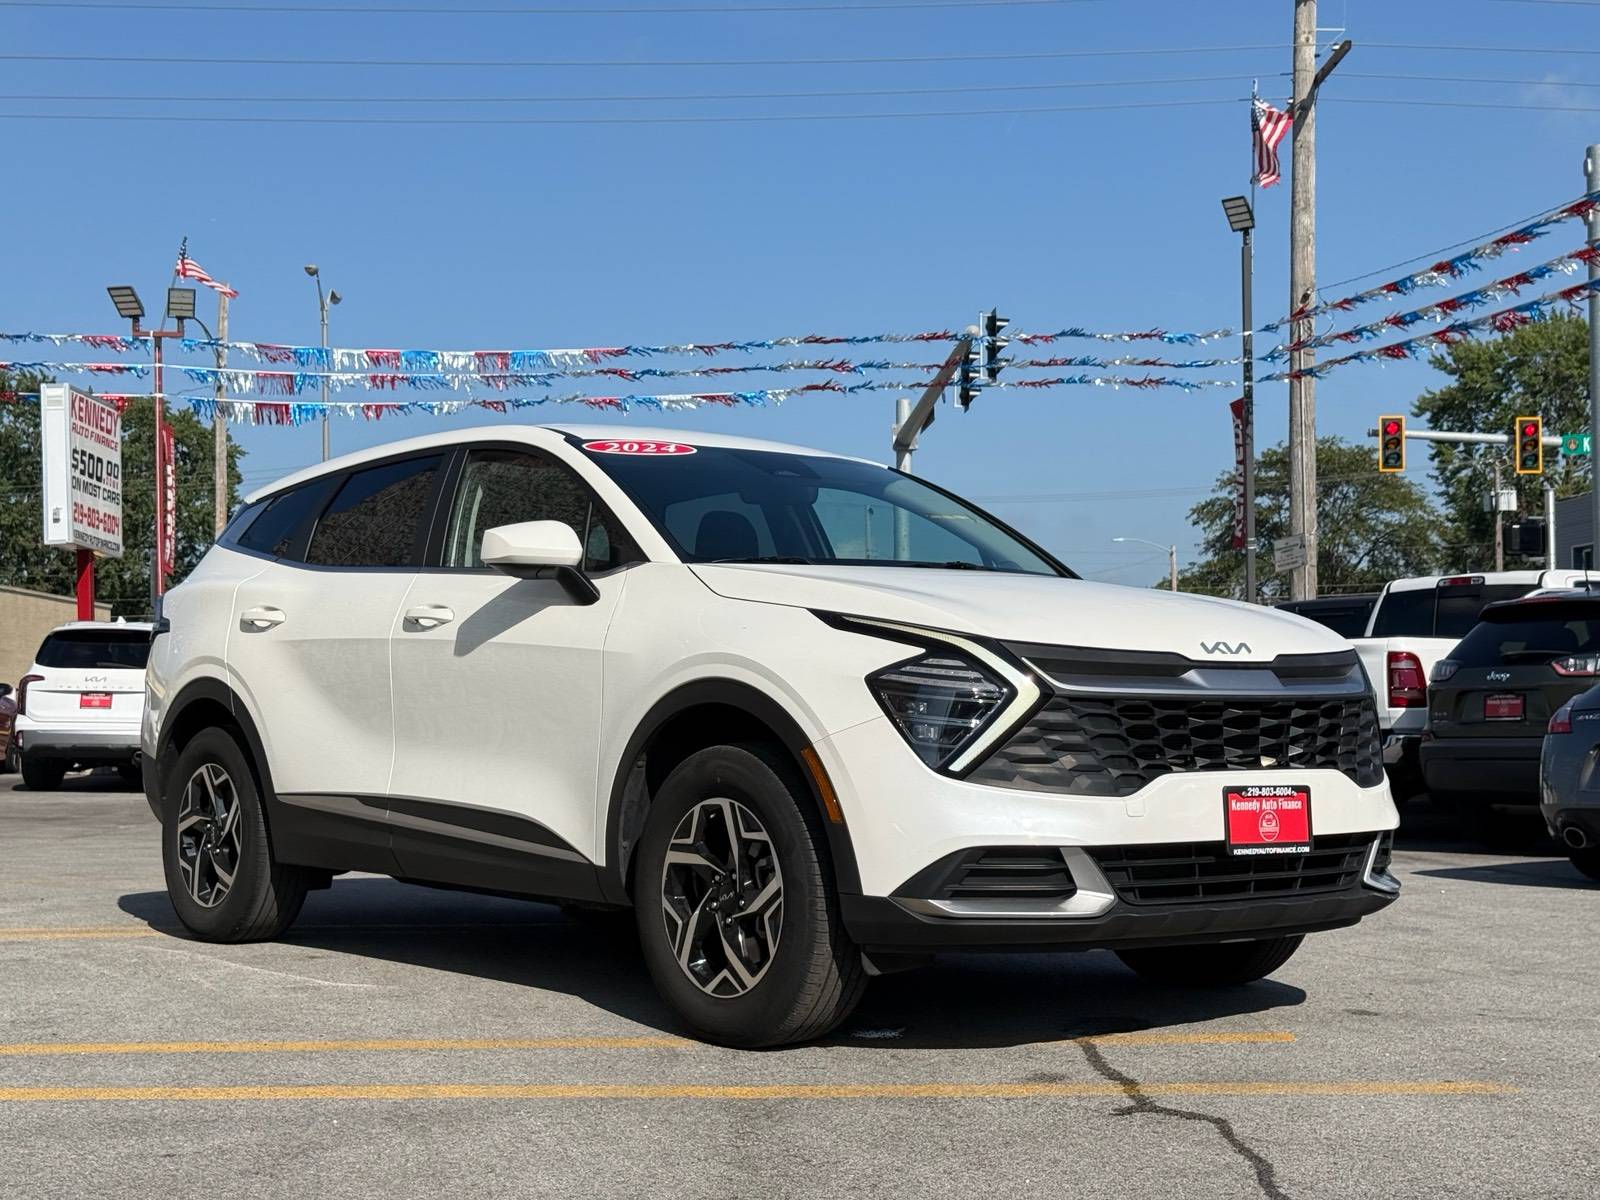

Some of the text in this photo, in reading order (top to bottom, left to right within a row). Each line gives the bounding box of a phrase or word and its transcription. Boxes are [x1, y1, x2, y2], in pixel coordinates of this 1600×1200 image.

[71, 391, 119, 438] KENNEDY
[72, 422, 119, 452] AUTO FINANCE
[605, 442, 678, 453] 2024
[72, 476, 81, 492] ON
[82, 480, 101, 499] MOST
[102, 488, 120, 506] CARS
[73, 501, 119, 536] 219-803-6004
[1231, 798, 1302, 813] Kennedy Auto Finance
[1247, 787, 1292, 797] 219-803-6004
